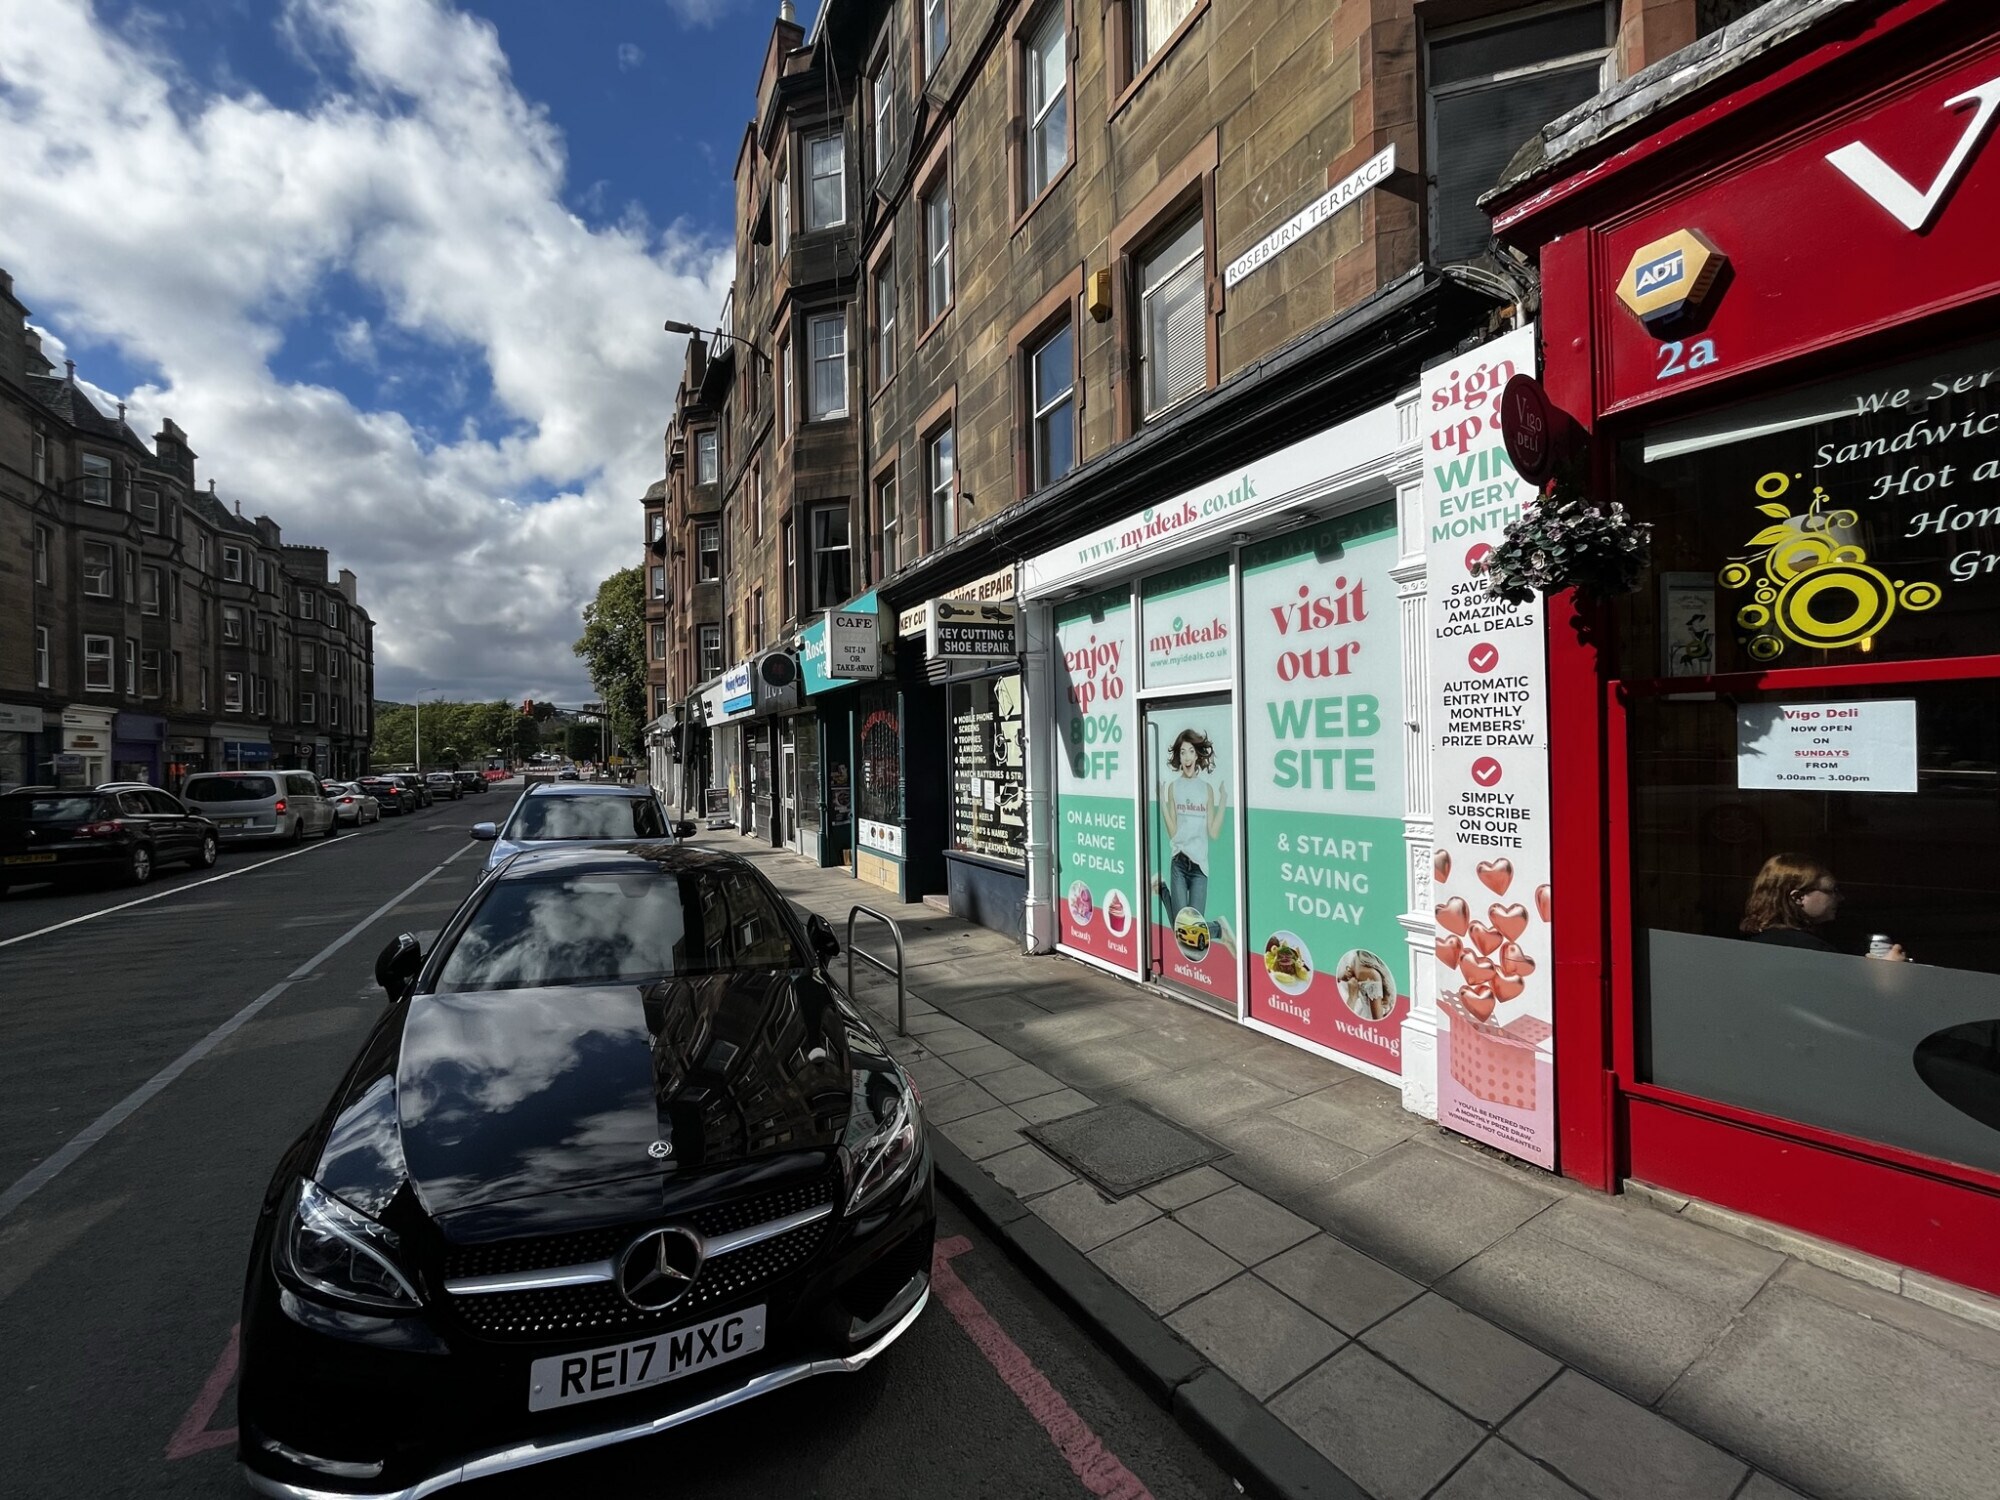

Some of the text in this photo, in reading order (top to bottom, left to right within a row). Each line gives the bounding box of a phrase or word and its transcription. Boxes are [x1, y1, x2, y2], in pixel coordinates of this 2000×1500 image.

[1228, 154, 1389, 283] ROSEBURN TERRACE
[1636, 259, 1683, 291] ADT
[1656, 338, 1719, 381] 2a
[1431, 359, 1516, 413] sign
[1855, 387, 1910, 417] We
[1515, 393, 1542, 434] Vigo
[1430, 414, 1482, 456] up
[1433, 445, 1517, 494] WIN
[1867, 464, 1957, 500] Hot
[1439, 477, 1520, 518] EVERY
[1078, 474, 1259, 565] www.myideals.co.uk
[978, 572, 1014, 601] REPAIR
[1451, 578, 1488, 596] SAVE
[1270, 575, 1370, 636] visit
[1442, 592, 1497, 611] TO 80%
[835, 616, 873, 629] CAFE
[900, 613, 913, 631] KEY
[1448, 603, 1518, 624] AMAZING
[938, 627, 1015, 640] KEY CUTTING &
[1149, 616, 1228, 656] myideals
[1436, 614, 1534, 639] LOCAL DEALS
[844, 645, 866, 654] SIT-IN
[944, 641, 1010, 654] SHOE REPAIR
[1064, 634, 1124, 680] enjoy
[1149, 647, 1228, 668] www.myideals.co.uk
[836, 663, 875, 673] TAKE-AWAY
[850, 654, 861, 663] OR
[1276, 640, 1361, 682] our
[1067, 669, 1124, 715] up to
[1443, 675, 1529, 693] AUTOMATIC
[1443, 690, 1530, 706] ENTRY INTO
[958, 712, 994, 724] MOBILE PHONE
[1266, 693, 1381, 740] WEB
[1450, 705, 1523, 720] MONTHLY
[1784, 708, 1859, 721] Vigo Deli
[958, 724, 980, 734] SCREENS
[1070, 713, 1122, 745] 80%
[1448, 719, 1525, 733] MEMBERS'
[1791, 725, 1817, 733] NOW
[963, 745, 983, 753] AWARDS
[1442, 734, 1534, 747] PRIZE DRAW
[1794, 749, 1850, 758] SUNDAYS
[960, 769, 976, 778] WATCH
[977, 770, 1004, 779] BATTERIES
[1005, 771, 1010, 779] &
[1073, 750, 1119, 780] OFF
[1272, 748, 1376, 792] SITE
[1776, 774, 1816, 782] 9.00am
[1828, 774, 1870, 782] 3.00pm
[1461, 792, 1515, 805] SIMPLY
[979, 812, 994, 822] HEELS
[1067, 810, 1126, 830] ON A HUGE
[1448, 805, 1531, 820] SUBSCRIBE
[986, 826, 991, 835] &
[991, 826, 1009, 839] NAMES
[1459, 819, 1518, 834] ON OUR
[1077, 831, 1115, 851] RANGE
[1277, 832, 1373, 862] & START
[1456, 832, 1523, 849] WEBSITE
[1072, 852, 1125, 875] OF DEALS
[1280, 862, 1369, 895] SAVING
[1285, 892, 1364, 926] TODAY
[1070, 925, 1092, 945] beauty
[1107, 940, 1128, 955] treats
[1174, 962, 1212, 985] activities
[1267, 994, 1311, 1025] dining
[1461, 1109, 1490, 1124] MONTHLY
[1491, 1121, 1510, 1133] PRIZE
[1479, 1108, 1488, 1117] BE
[1488, 1112, 1518, 1128] ENTERED
[1519, 1124, 1536, 1135] INTO
[1448, 1111, 1476, 1127] WINNING
[1482, 1125, 1496, 1135] NOT
[1496, 1131, 1542, 1153] GUARANTEED
[560, 1316, 744, 1398] RE17 MXG
